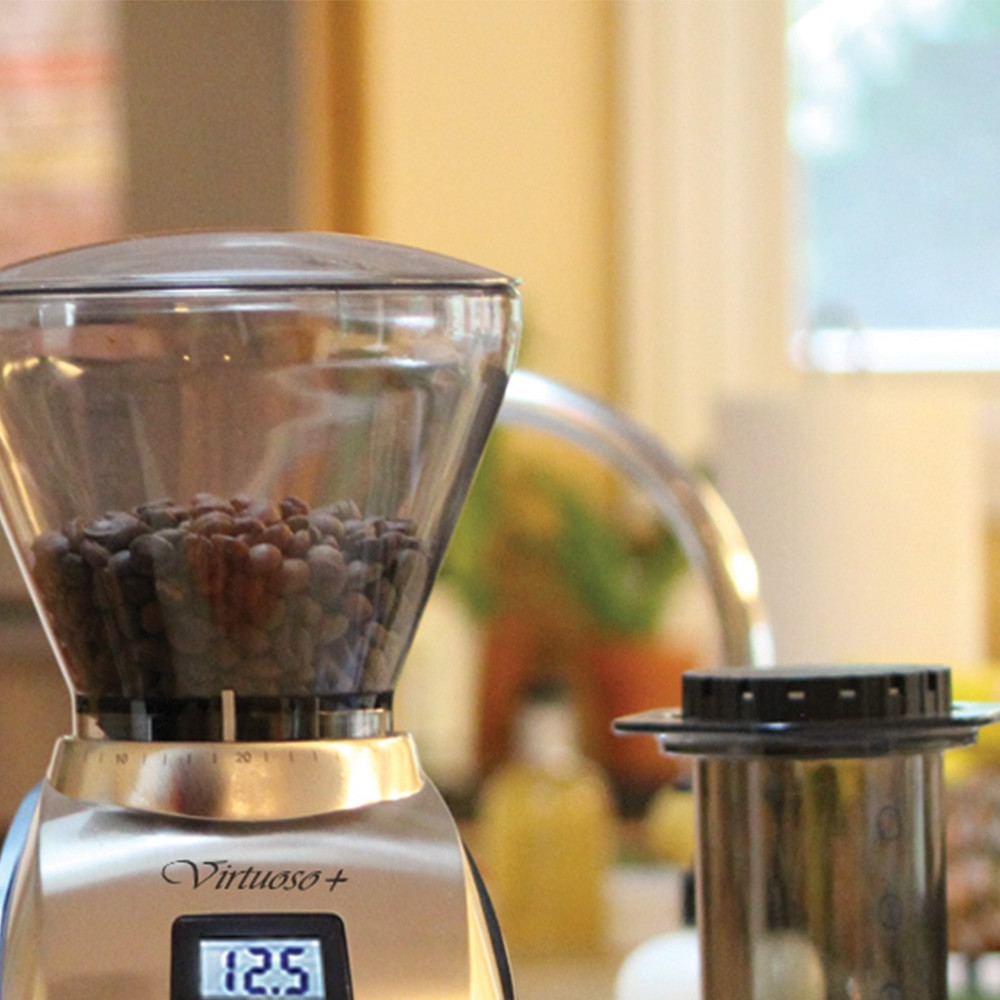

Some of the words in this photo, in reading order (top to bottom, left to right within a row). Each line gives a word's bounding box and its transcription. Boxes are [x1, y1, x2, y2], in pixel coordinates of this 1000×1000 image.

[115, 754, 128, 764] 10
[235, 752, 252, 764] 20
[225, 946, 310, 995] 12.5
